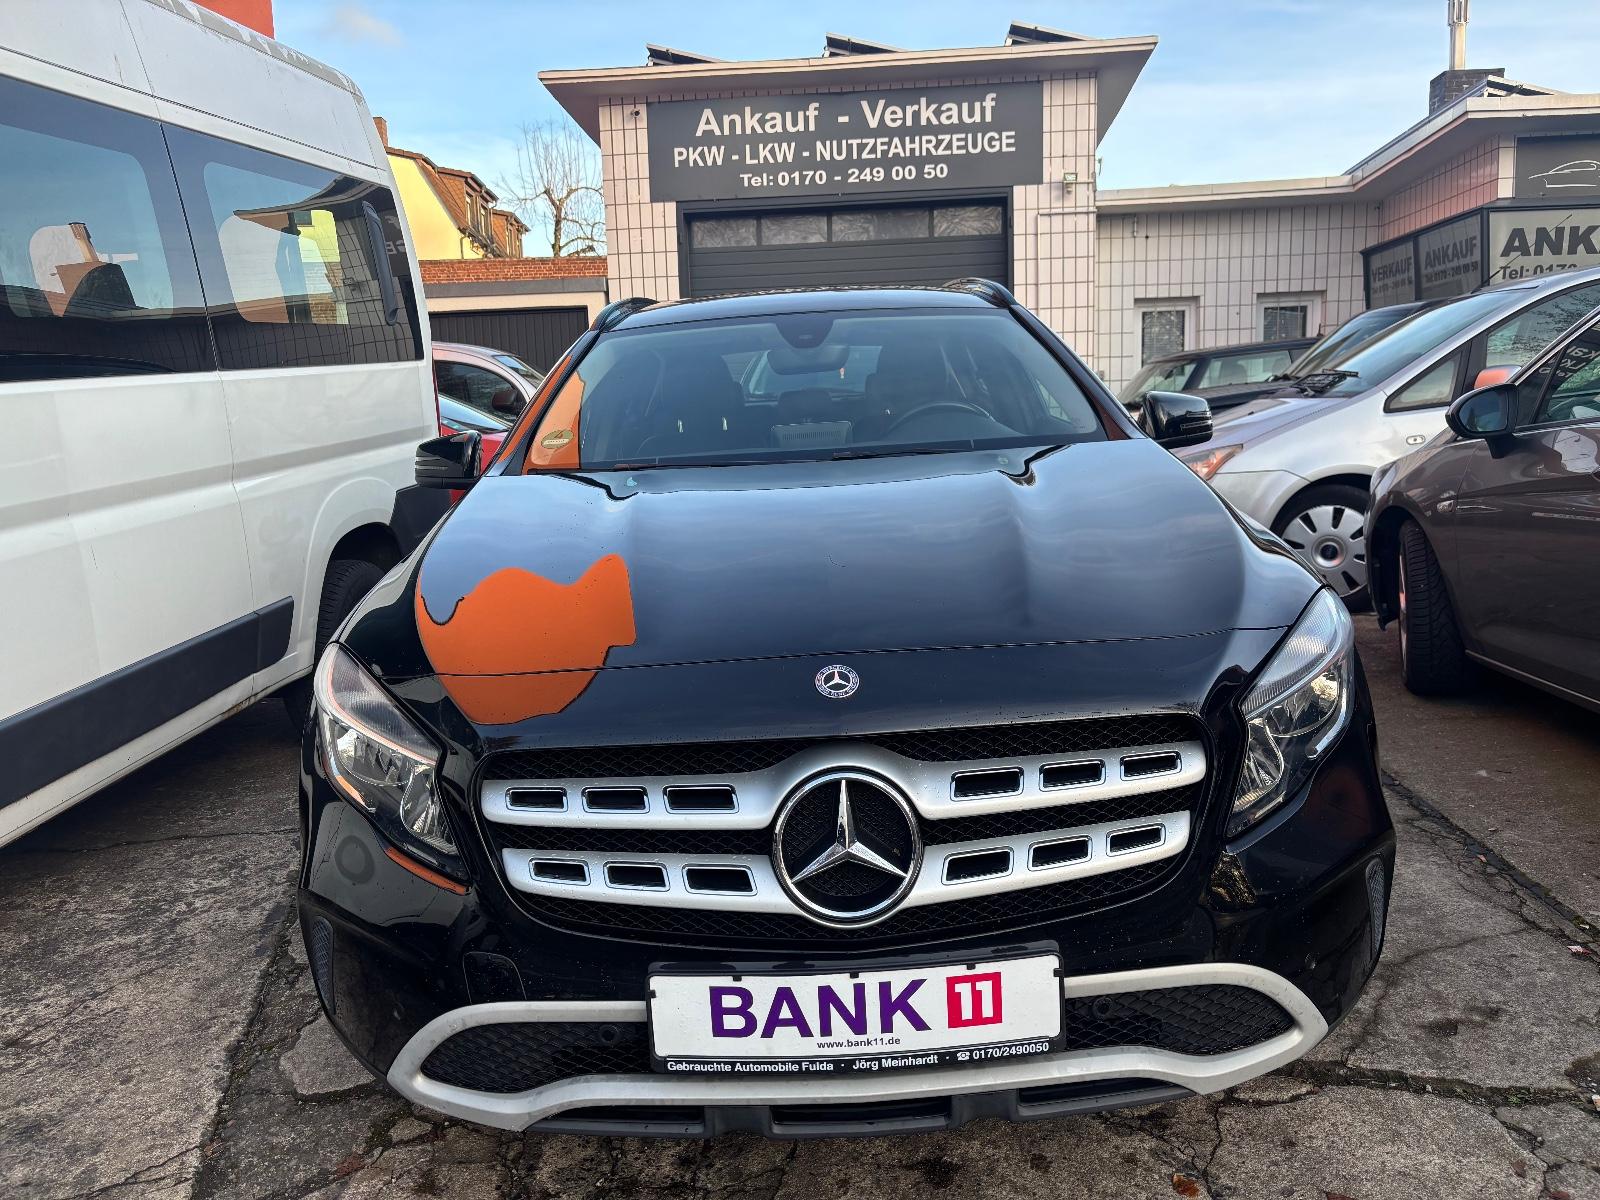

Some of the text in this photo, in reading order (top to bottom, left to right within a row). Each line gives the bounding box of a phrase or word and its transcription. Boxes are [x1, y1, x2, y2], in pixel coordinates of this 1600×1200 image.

[695, 102, 820, 137] Ankauf
[860, 92, 997, 129] Verkauf
[673, 145, 725, 168] PKW
[744, 141, 796, 165] LKW
[815, 130, 1016, 162] NUTZFAHRZEUGE
[847, 167, 885, 183] 249
[891, 165, 917, 181] 00
[923, 163, 949, 179] 50
[1424, 235, 1477, 270] ANKAUF
[1499, 224, 1600, 257] ANK
[1371, 256, 1412, 283] VERKAUF
[708, 977, 994, 1039] BANK 11
[667, 1061, 732, 1073] Gebrauchte
[739, 1061, 800, 1072] Automobile
[801, 1060, 834, 1072] Fulda
[852, 1058, 879, 1070] Jörg
[881, 1054, 939, 1068] Meinhardt
[972, 1042, 1050, 1060] 0170/2490050
[816, 1036, 901, 1049] www.bank11.de
